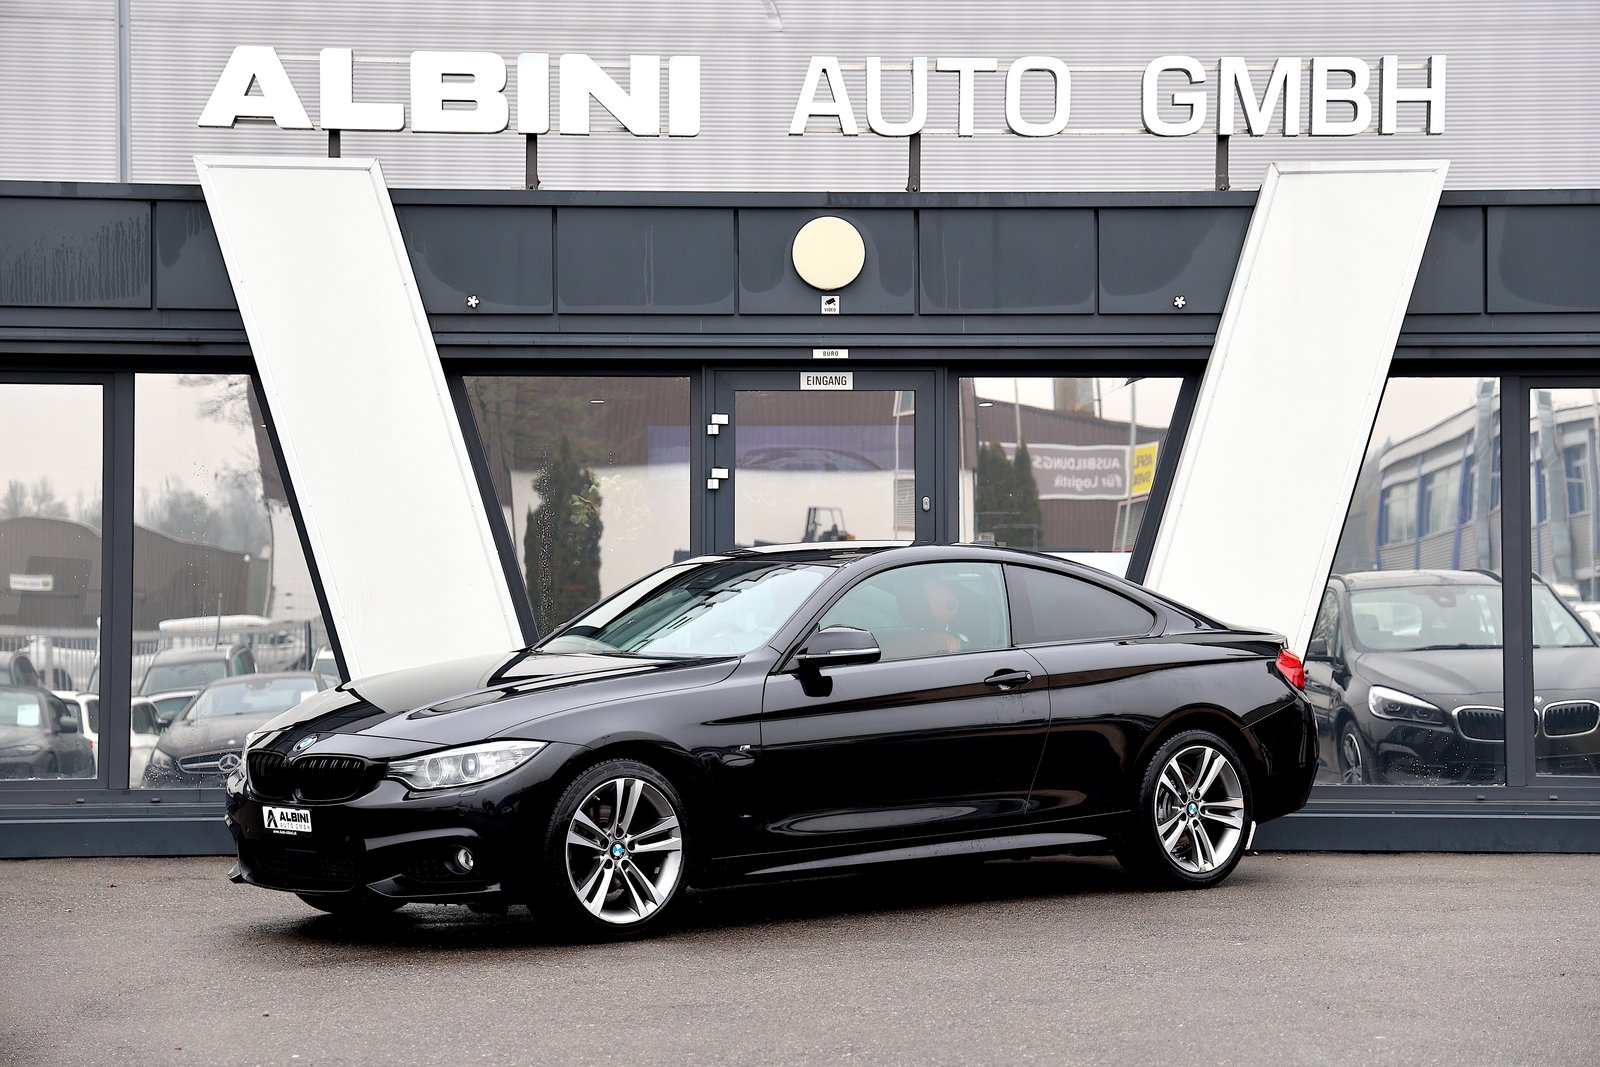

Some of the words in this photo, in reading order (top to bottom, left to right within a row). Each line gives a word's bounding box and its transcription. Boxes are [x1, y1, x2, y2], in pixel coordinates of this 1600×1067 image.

[197, 45, 701, 137] ALBINI
[788, 55, 1072, 138] AUTO
[1141, 54, 1448, 137] GMBH
[806, 375, 847, 386] EINGANG
[280, 811, 309, 823] ALBINI
